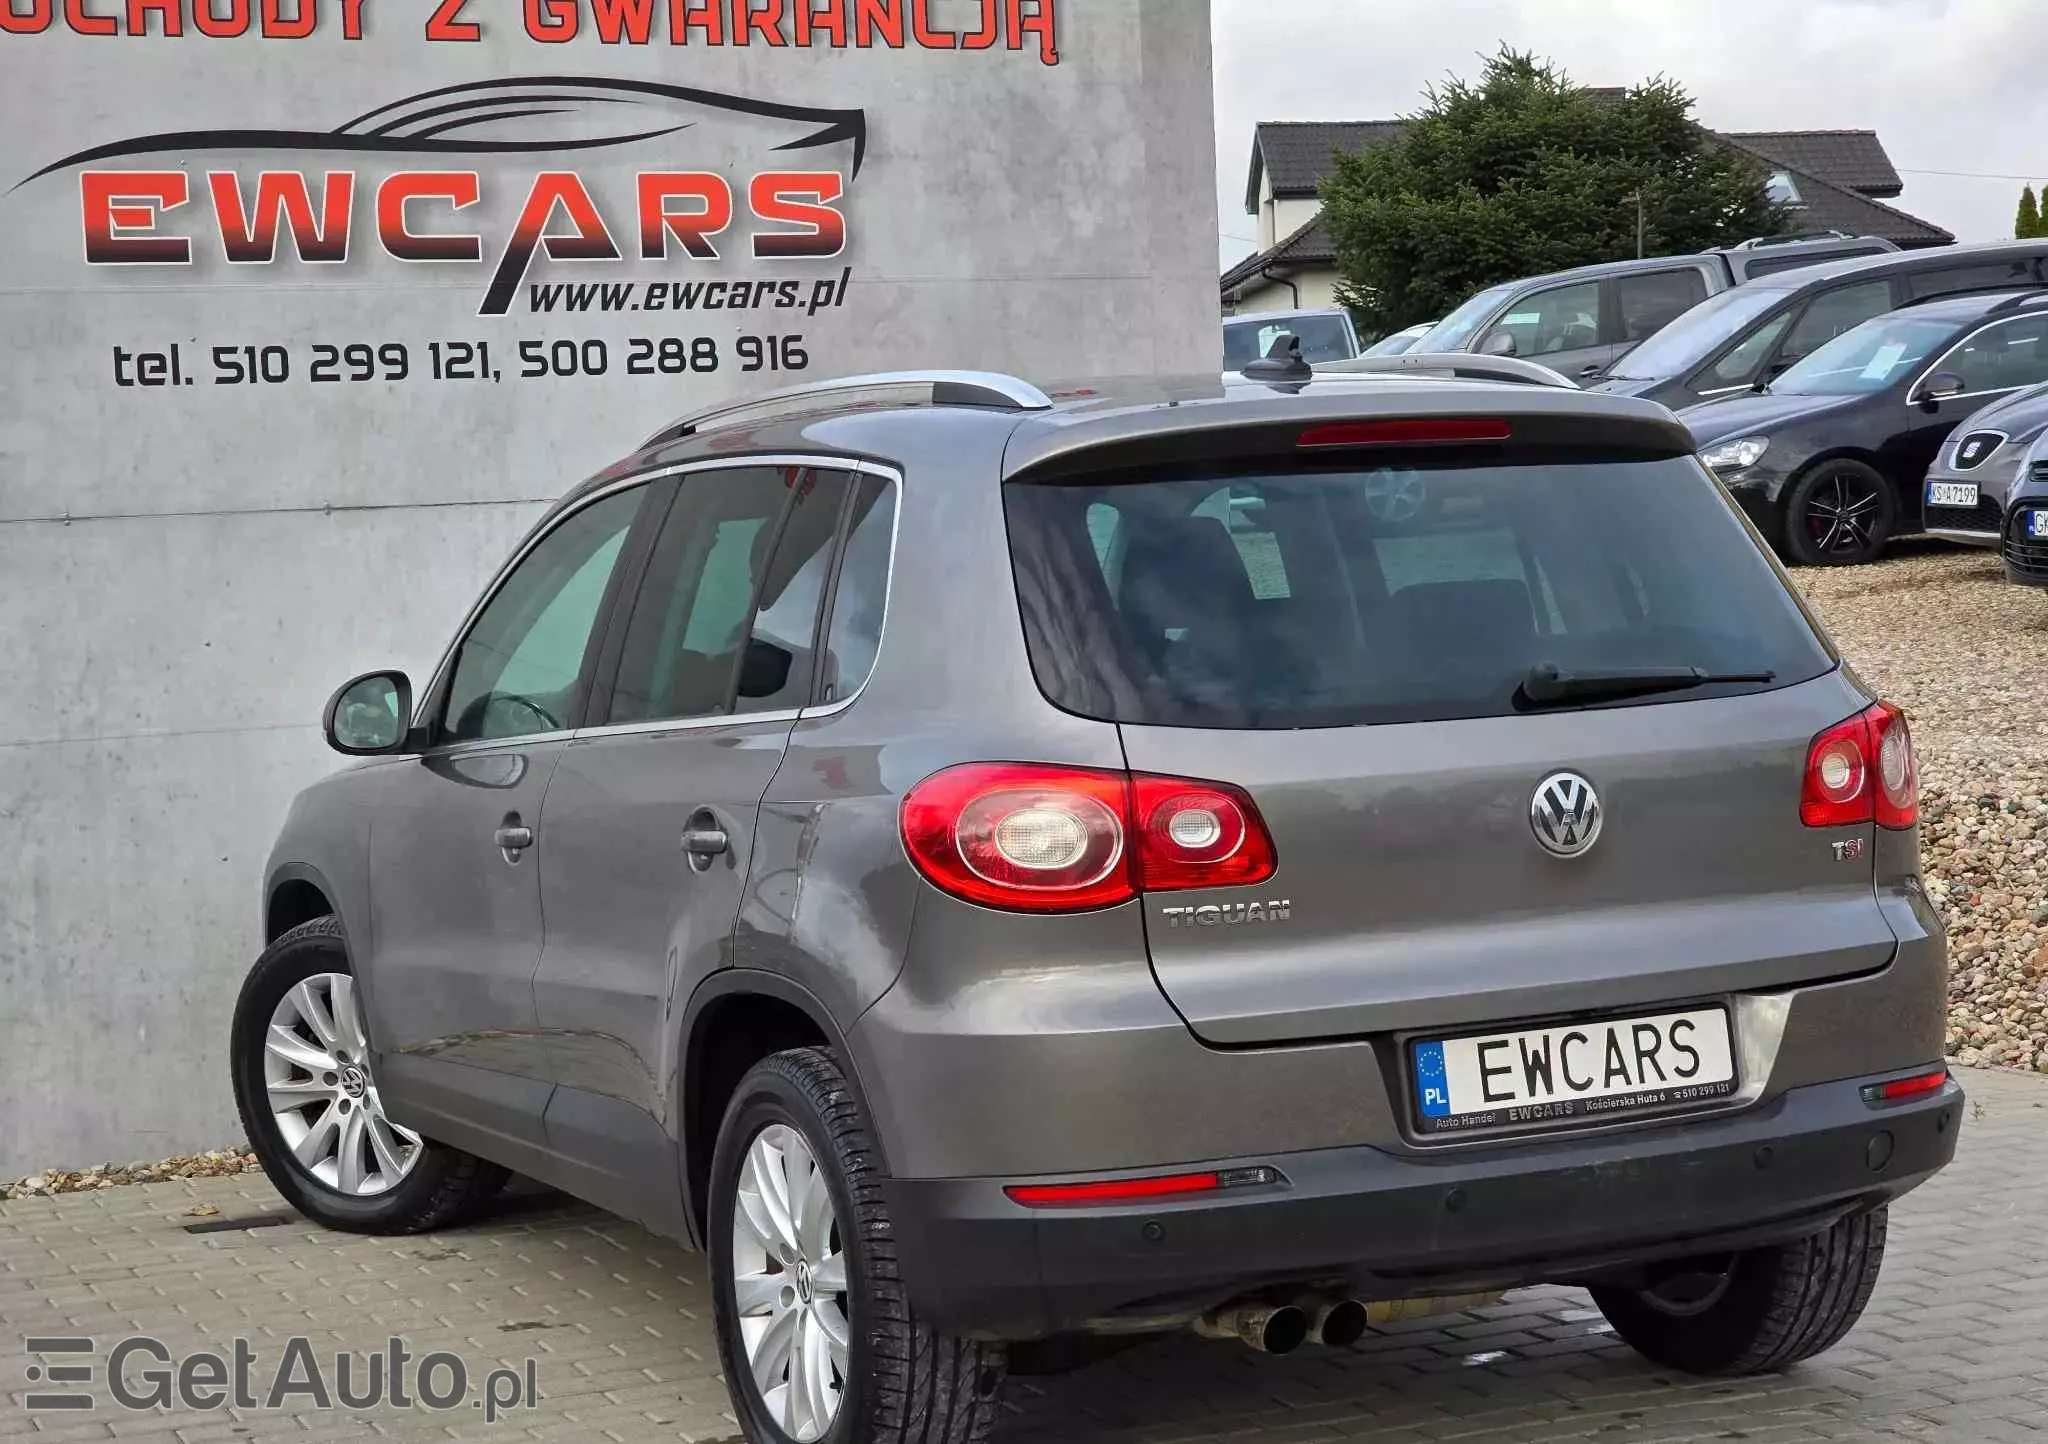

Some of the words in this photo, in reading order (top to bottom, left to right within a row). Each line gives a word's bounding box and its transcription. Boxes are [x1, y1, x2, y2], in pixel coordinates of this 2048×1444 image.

[425, 0, 482, 43] Z
[79, 170, 847, 317] EWCARS
[529, 266, 853, 317] www.ewcars.pl
[113, 343, 194, 387] tel.
[212, 344, 290, 385] 510
[310, 342, 409, 384] 299
[427, 341, 501, 384] 121,
[518, 339, 608, 378] 500
[626, 337, 719, 375] 288
[735, 335, 810, 372] 916
[1831, 838, 1864, 861] TSI
[1162, 899, 1292, 929] TIGUAN
[1477, 1019, 1701, 1103] EWCARS
[1425, 1087, 1448, 1106] PL
[1436, 1116, 1460, 1129] Auto
[1461, 1112, 1497, 1126] Handel
[1508, 1101, 1575, 1121] EWCARS
[1637, 1092, 1658, 1105] Huta
[1682, 1088, 1698, 1099] 510
[1699, 1084, 1714, 1096] 299
[1716, 1082, 1730, 1094] 121
